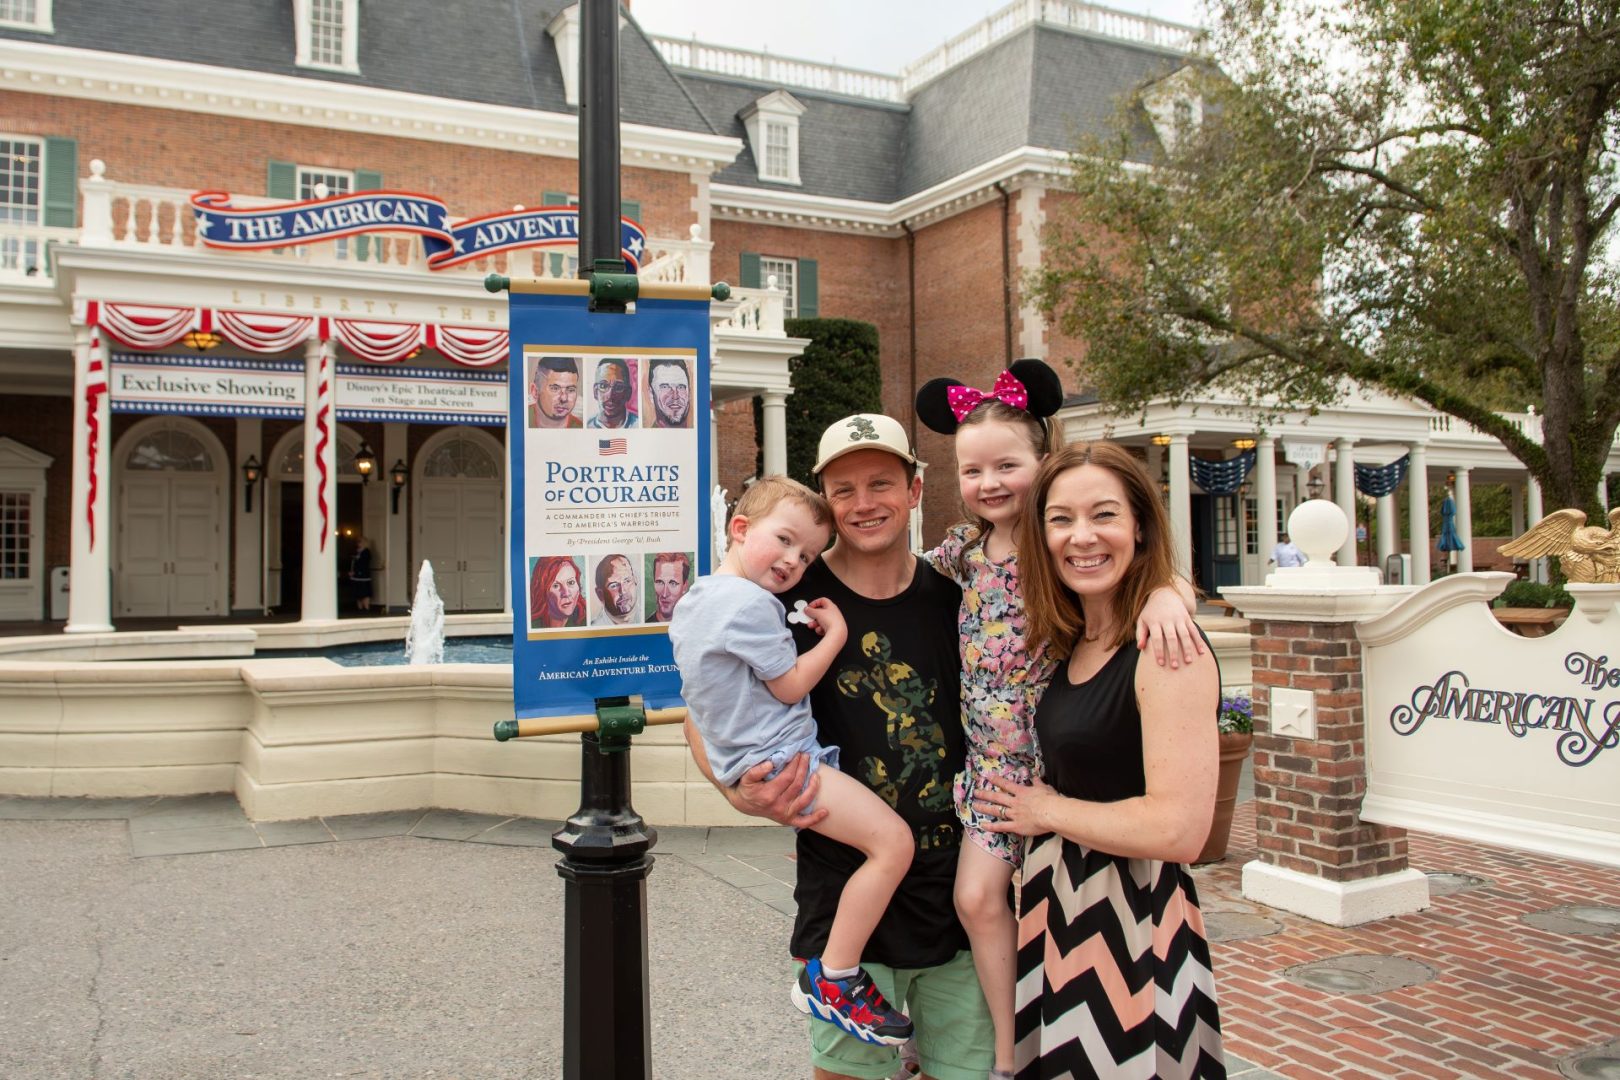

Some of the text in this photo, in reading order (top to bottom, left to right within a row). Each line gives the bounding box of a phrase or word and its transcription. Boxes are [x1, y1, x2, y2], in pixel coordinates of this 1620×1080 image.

[225, 215, 285, 240] THE
[292, 200, 430, 235] AMERICAN
[232, 290, 400, 315] LIBERTY
[121, 373, 296, 400] Exclusive Showing
[346, 381, 498, 398] Disney's Epic Theatrical Event
[371, 395, 474, 408] on Stage and Screen
[545, 461, 679, 483] PORTRAITS
[544, 485, 680, 504] OF COURAGE
[619, 511, 649, 519] CHIEF'S
[575, 521, 618, 529] AMERICA'S
[566, 538, 577, 547] By
[577, 536, 611, 545] President
[611, 536, 634, 545] George
[646, 535, 661, 544] Bush
[582, 654, 650, 666] An Exhibit Inside the
[538, 670, 589, 681] AMERICAN
[591, 666, 646, 677] ADVENTURE
[1564, 651, 1620, 691] The
[1389, 670, 1606, 749] AMERICAN
